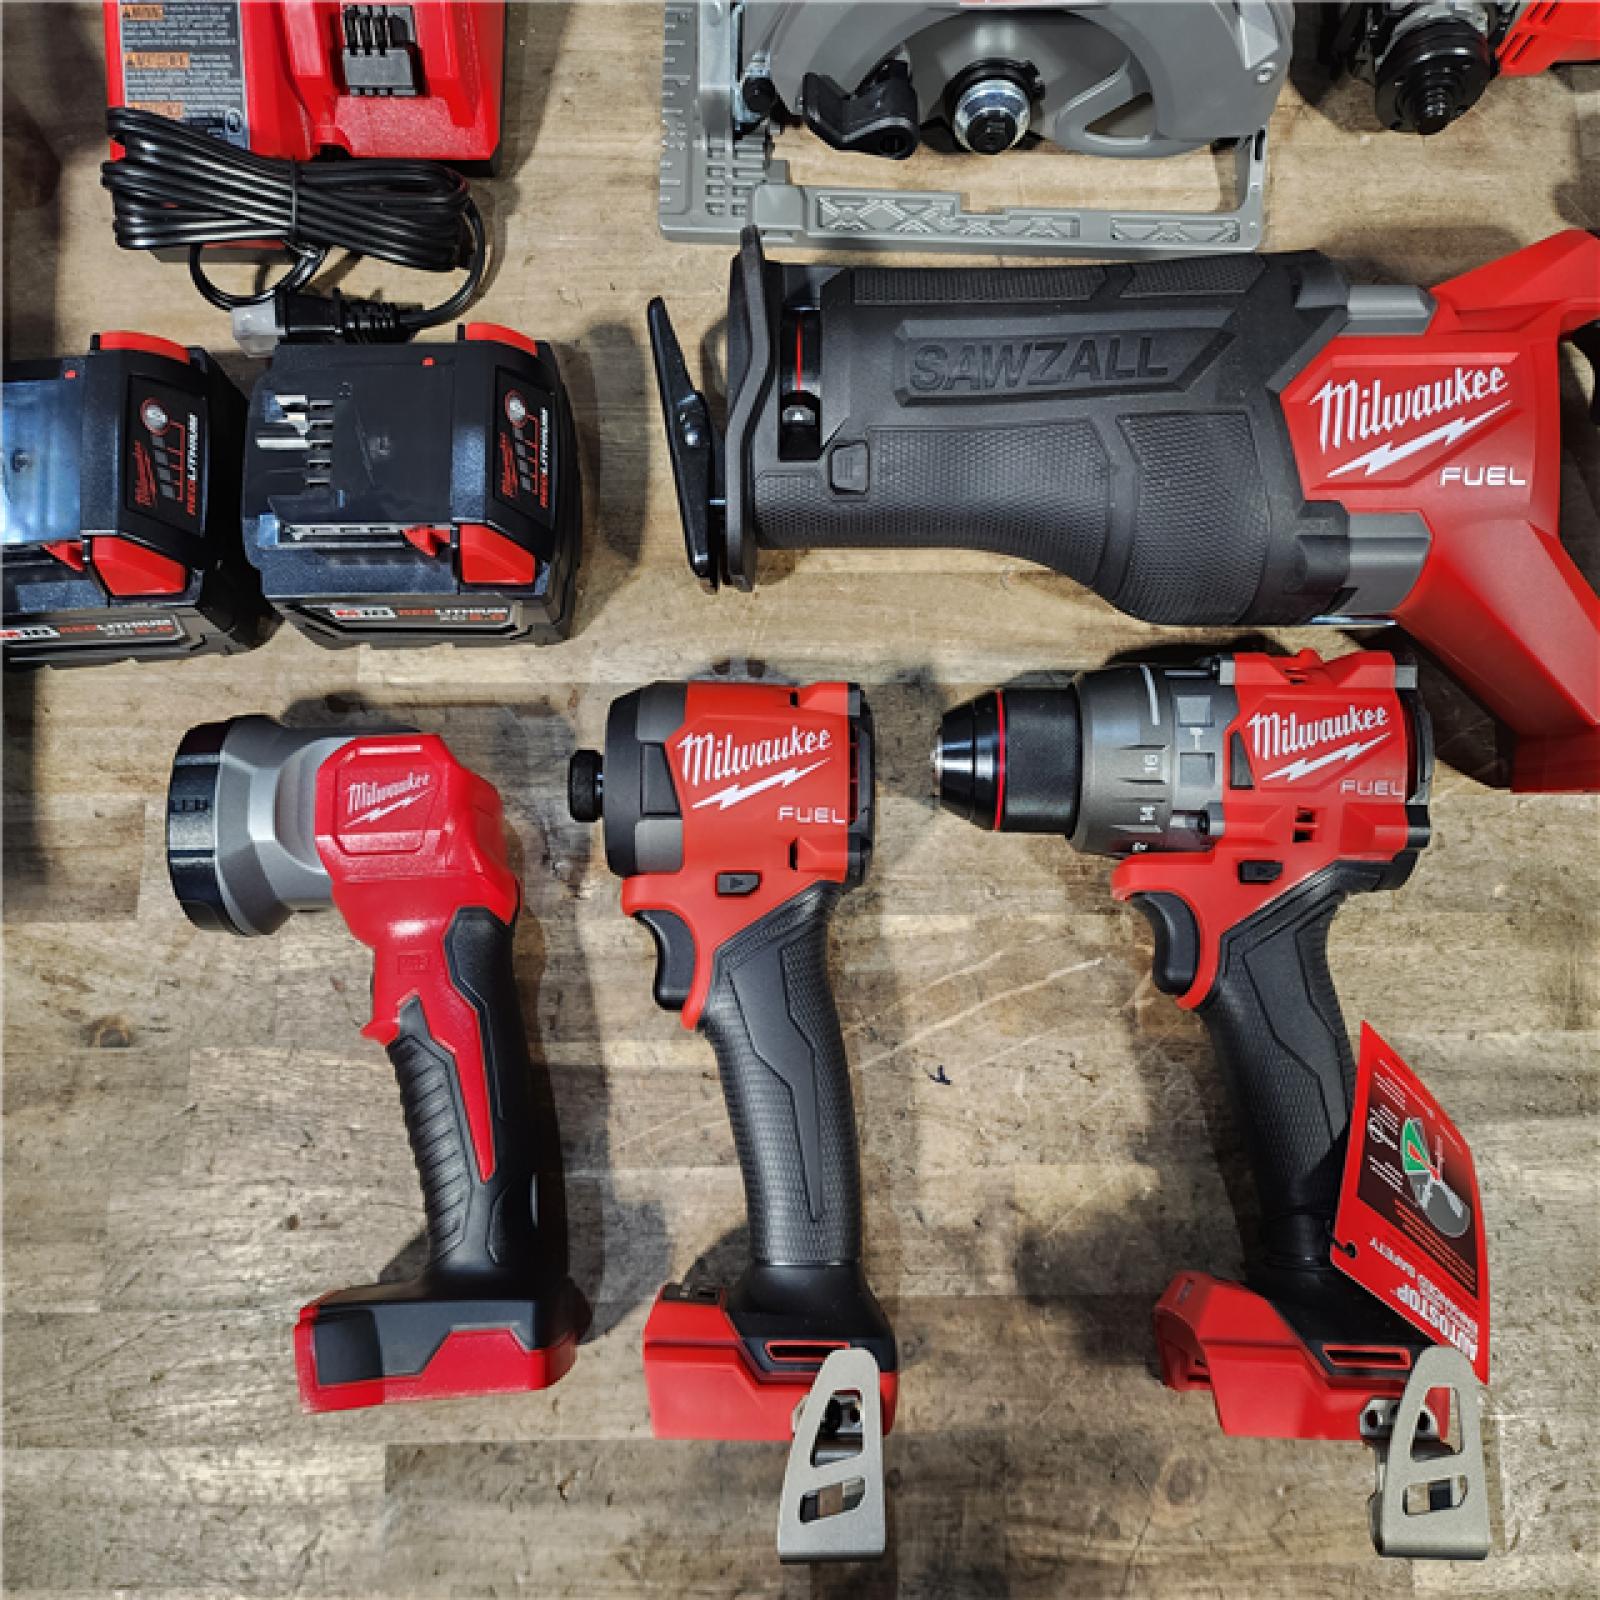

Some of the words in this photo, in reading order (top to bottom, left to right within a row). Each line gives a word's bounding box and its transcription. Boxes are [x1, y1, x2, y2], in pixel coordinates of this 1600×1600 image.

[910, 337, 1168, 391] SAWZALL
[1309, 367, 1510, 454] Milwaukee
[1439, 465, 1527, 487] FUEL
[677, 725, 833, 786] Milwaukee
[1247, 705, 1389, 760] Milwaukee
[344, 769, 431, 816] Milwaukee
[1340, 779, 1406, 796] FUEL
[777, 806, 846, 824] FUEL
